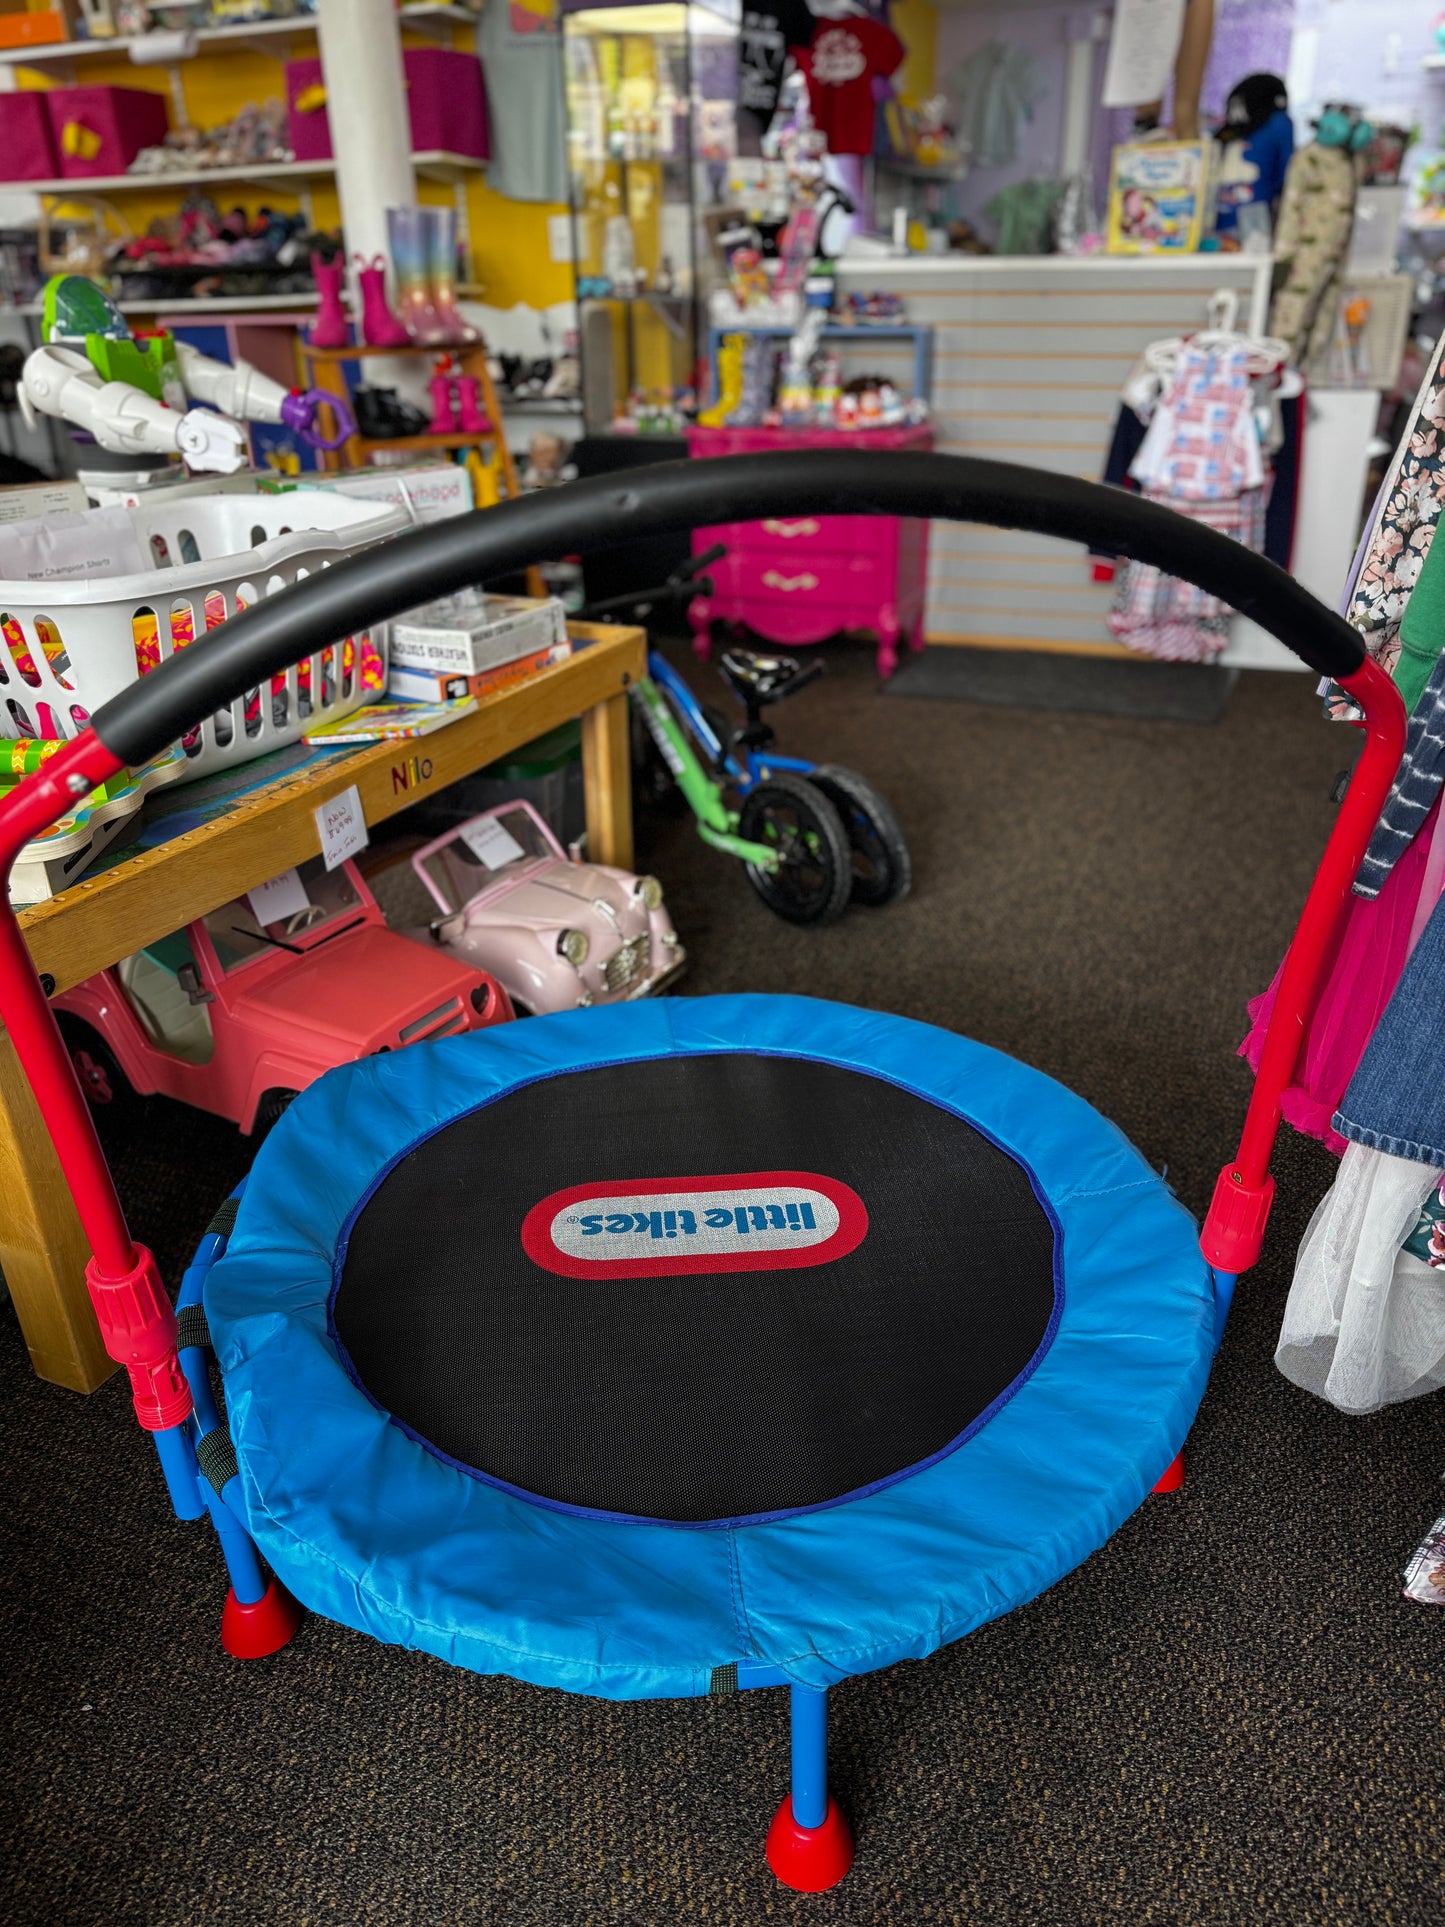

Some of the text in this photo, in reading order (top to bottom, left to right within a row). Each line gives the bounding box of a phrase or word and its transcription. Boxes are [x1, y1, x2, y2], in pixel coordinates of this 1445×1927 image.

[27, 558, 110, 579] New Champion Shorts
[391, 756, 433, 795] Nilo
[703, 1201, 817, 1236] little
